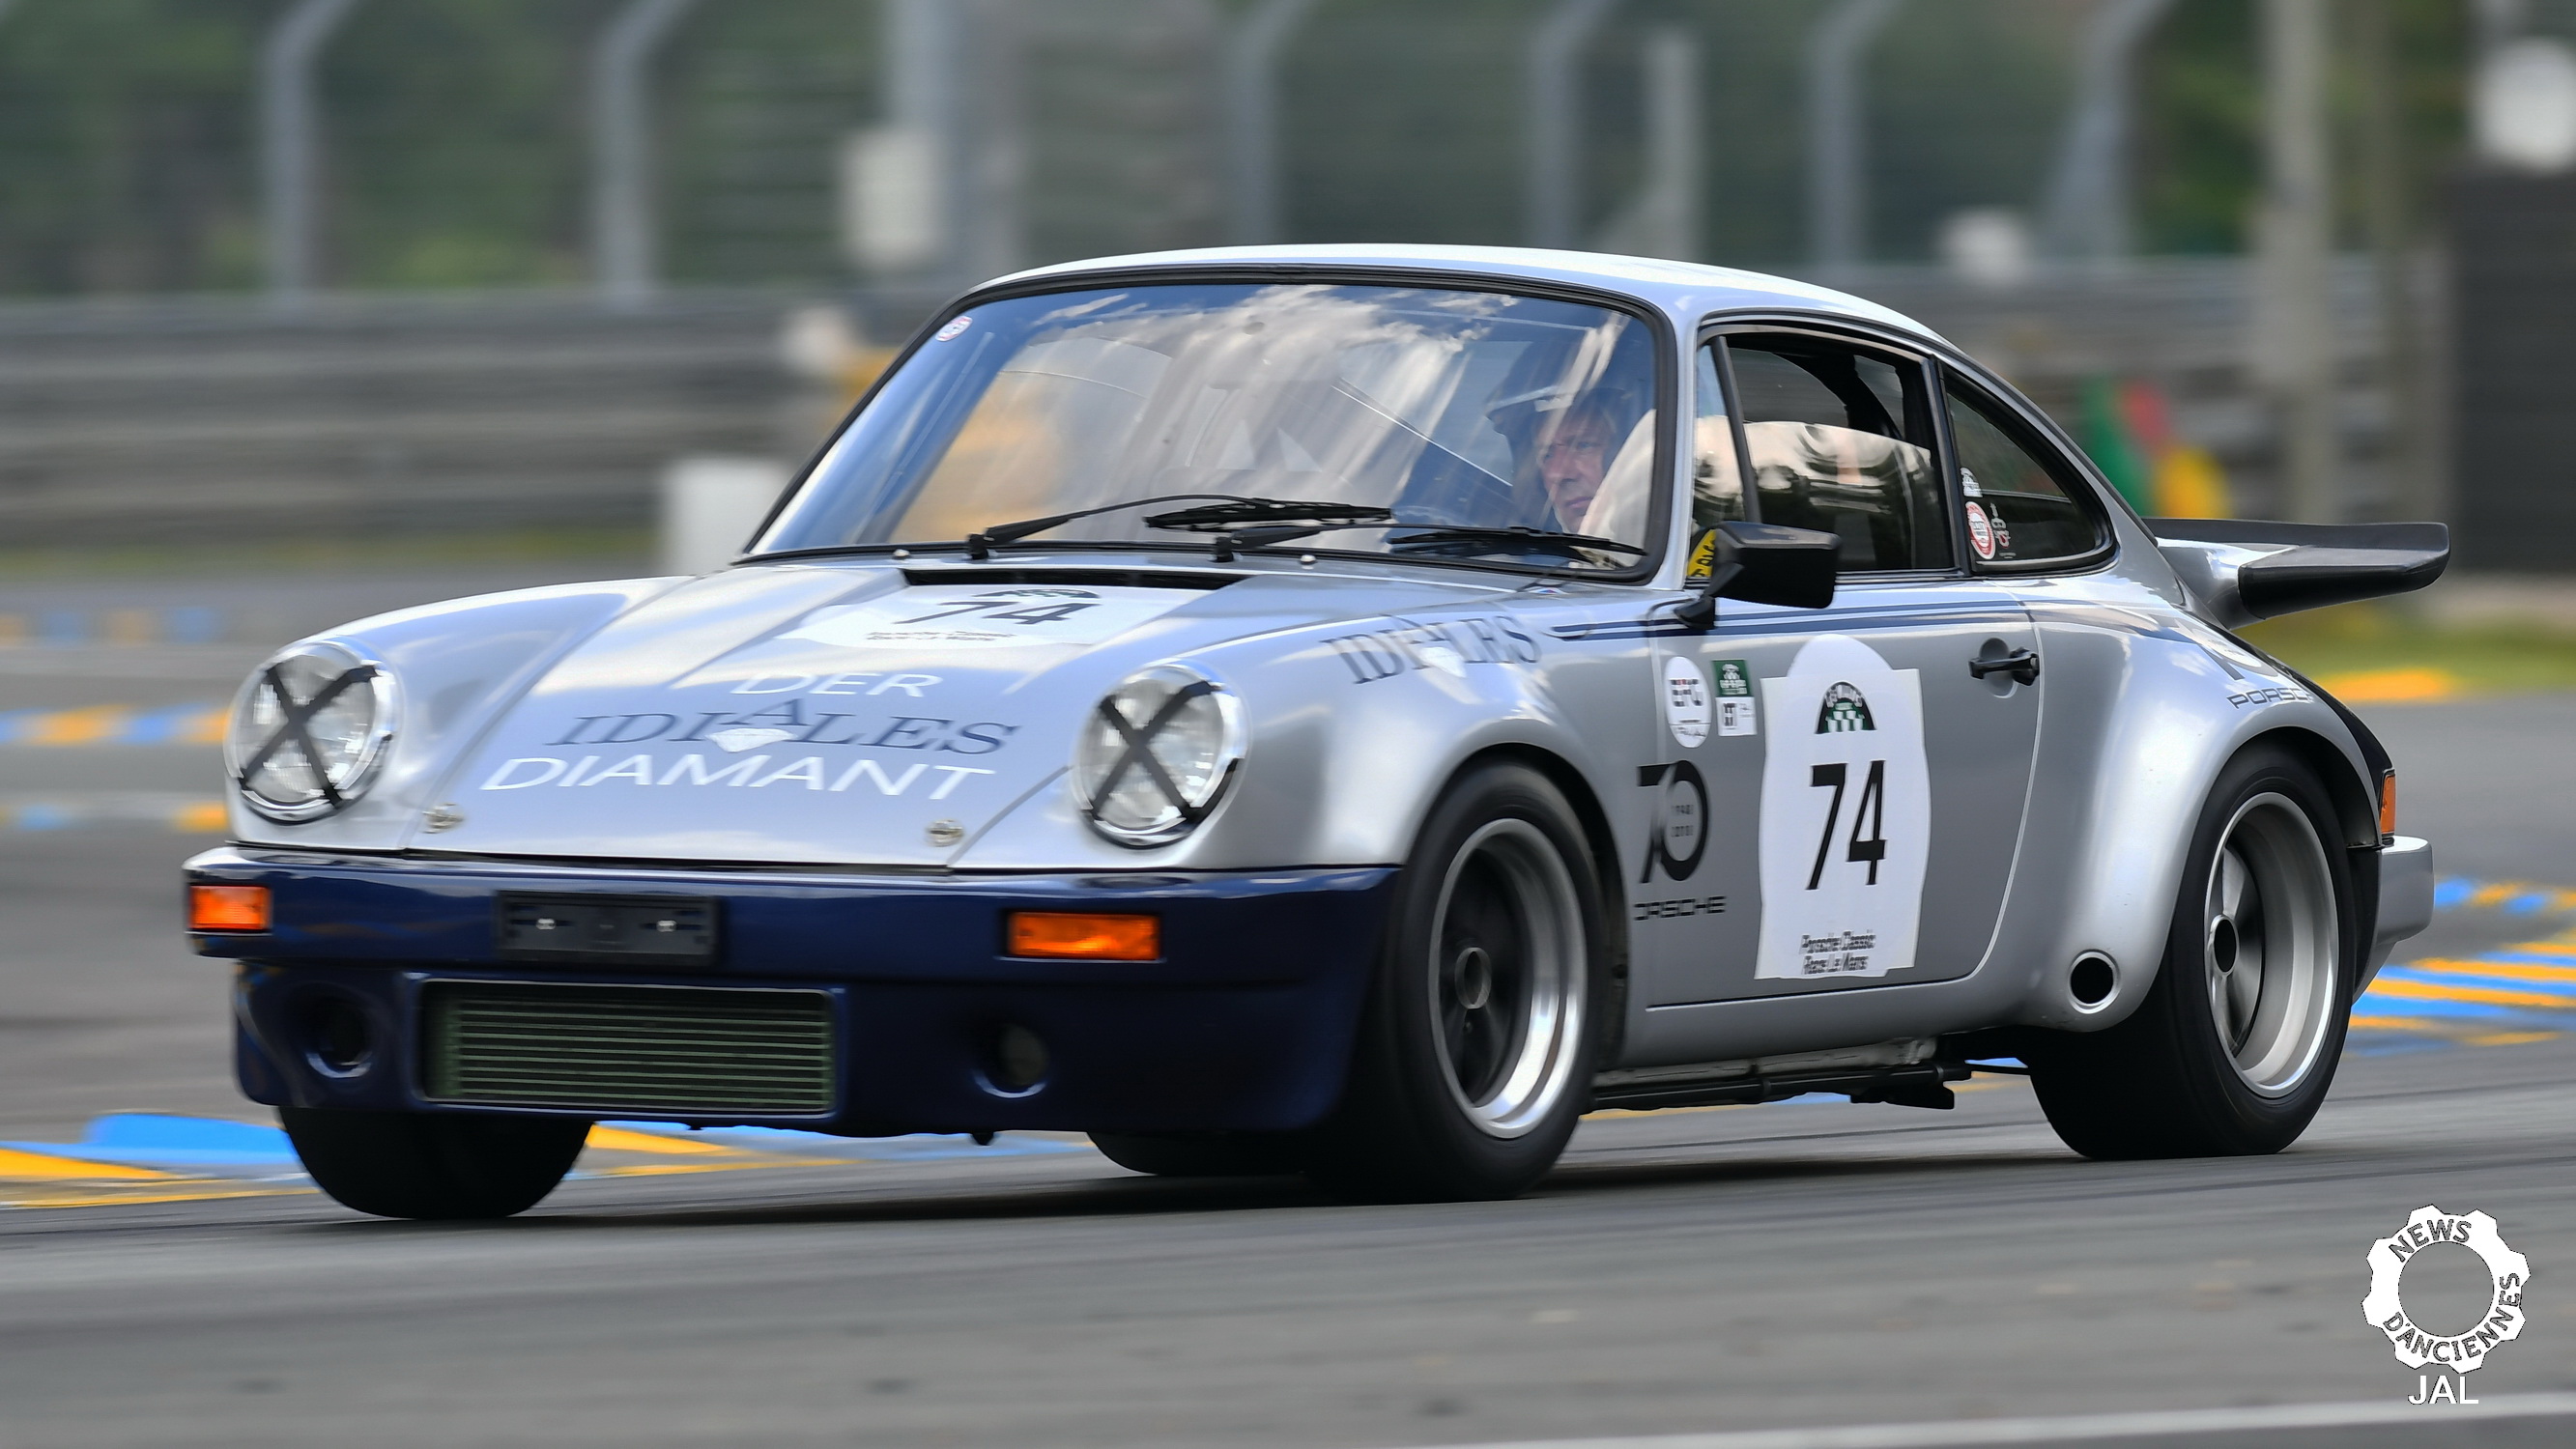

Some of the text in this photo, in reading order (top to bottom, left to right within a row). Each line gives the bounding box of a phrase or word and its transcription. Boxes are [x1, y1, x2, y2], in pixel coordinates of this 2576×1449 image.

[892, 601, 1102, 625] 74
[729, 673, 944, 696] DER
[479, 753, 996, 800] DIAMANT
[1637, 759, 1710, 884] 70
[1805, 760, 1887, 891] 74
[1634, 895, 1727, 920] ORSCHE
